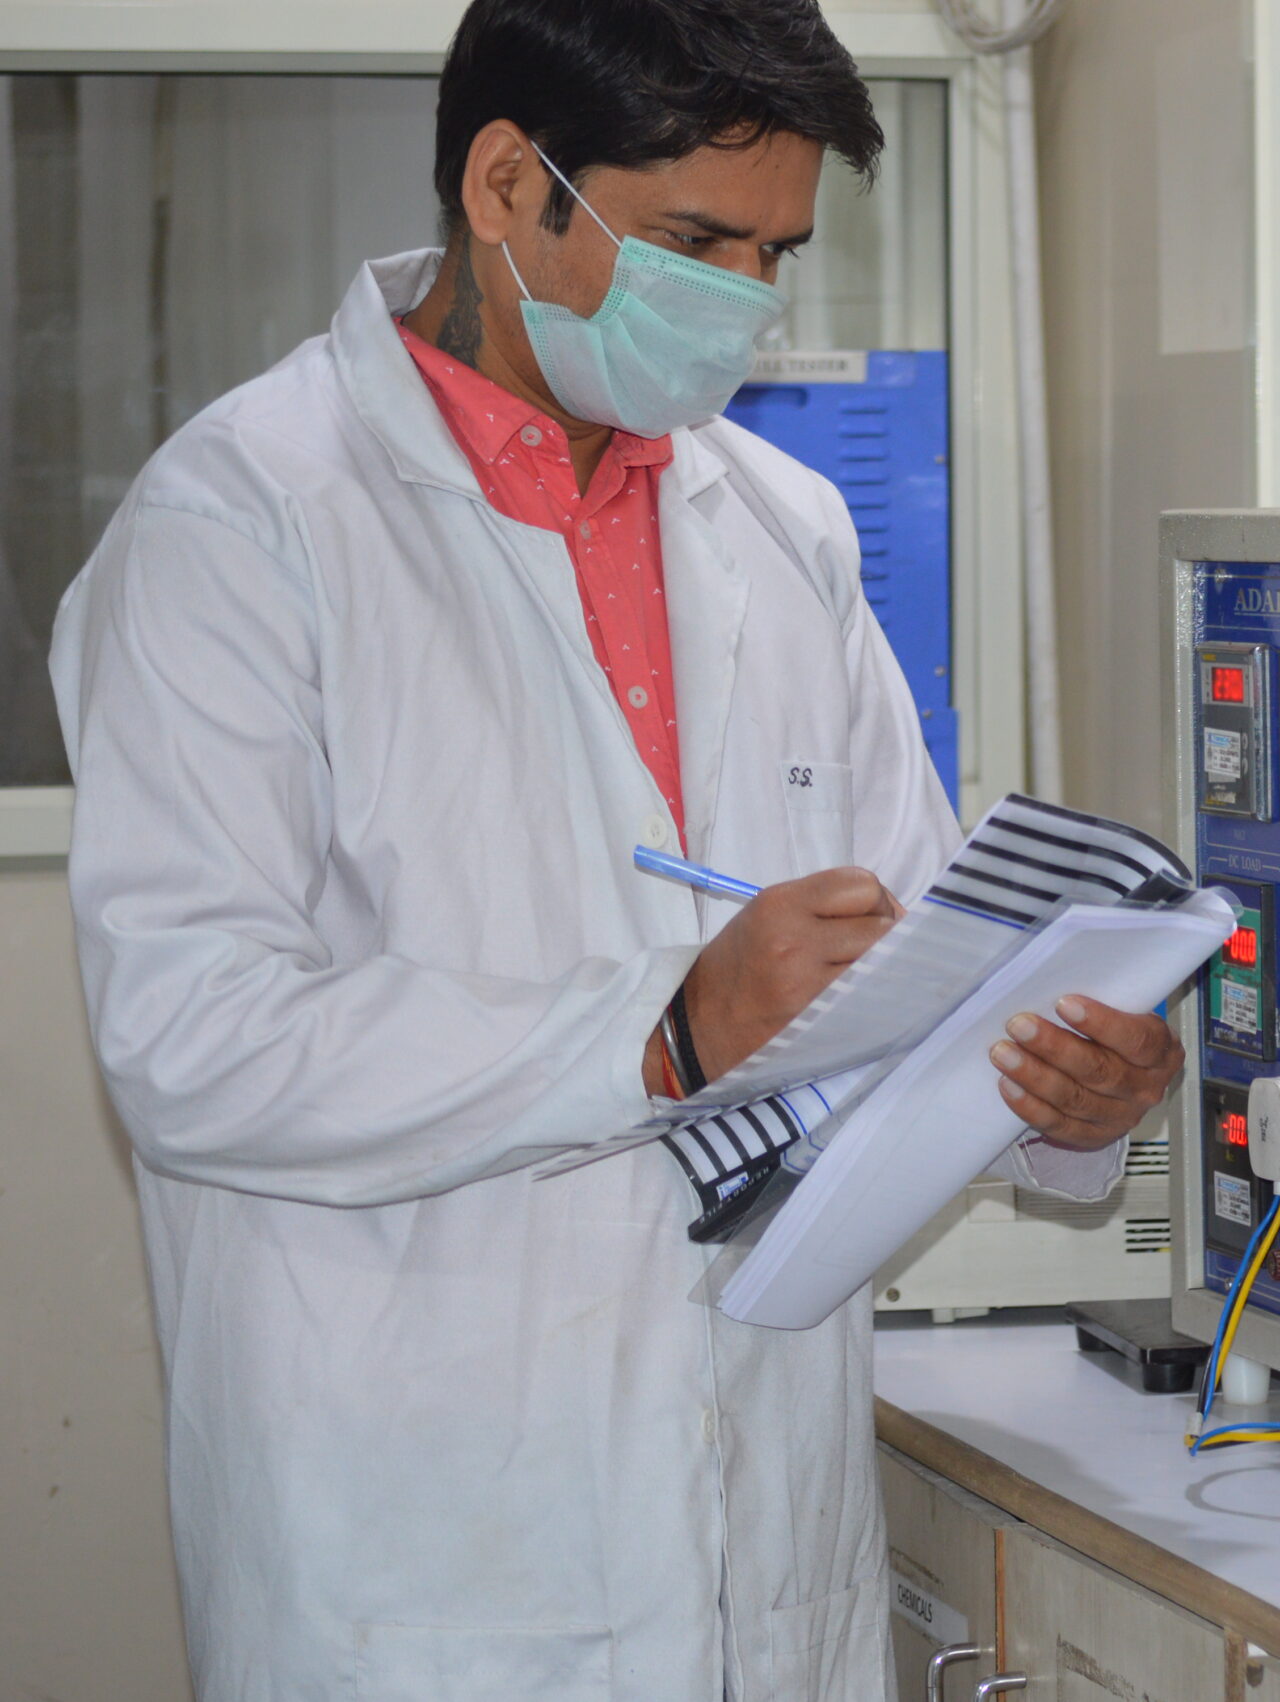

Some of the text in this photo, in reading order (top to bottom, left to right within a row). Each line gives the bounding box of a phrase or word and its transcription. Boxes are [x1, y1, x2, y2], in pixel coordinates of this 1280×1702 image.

[1228, 854, 1262, 872] DC LOAD
[897, 1583, 933, 1624] CHEMICALS
